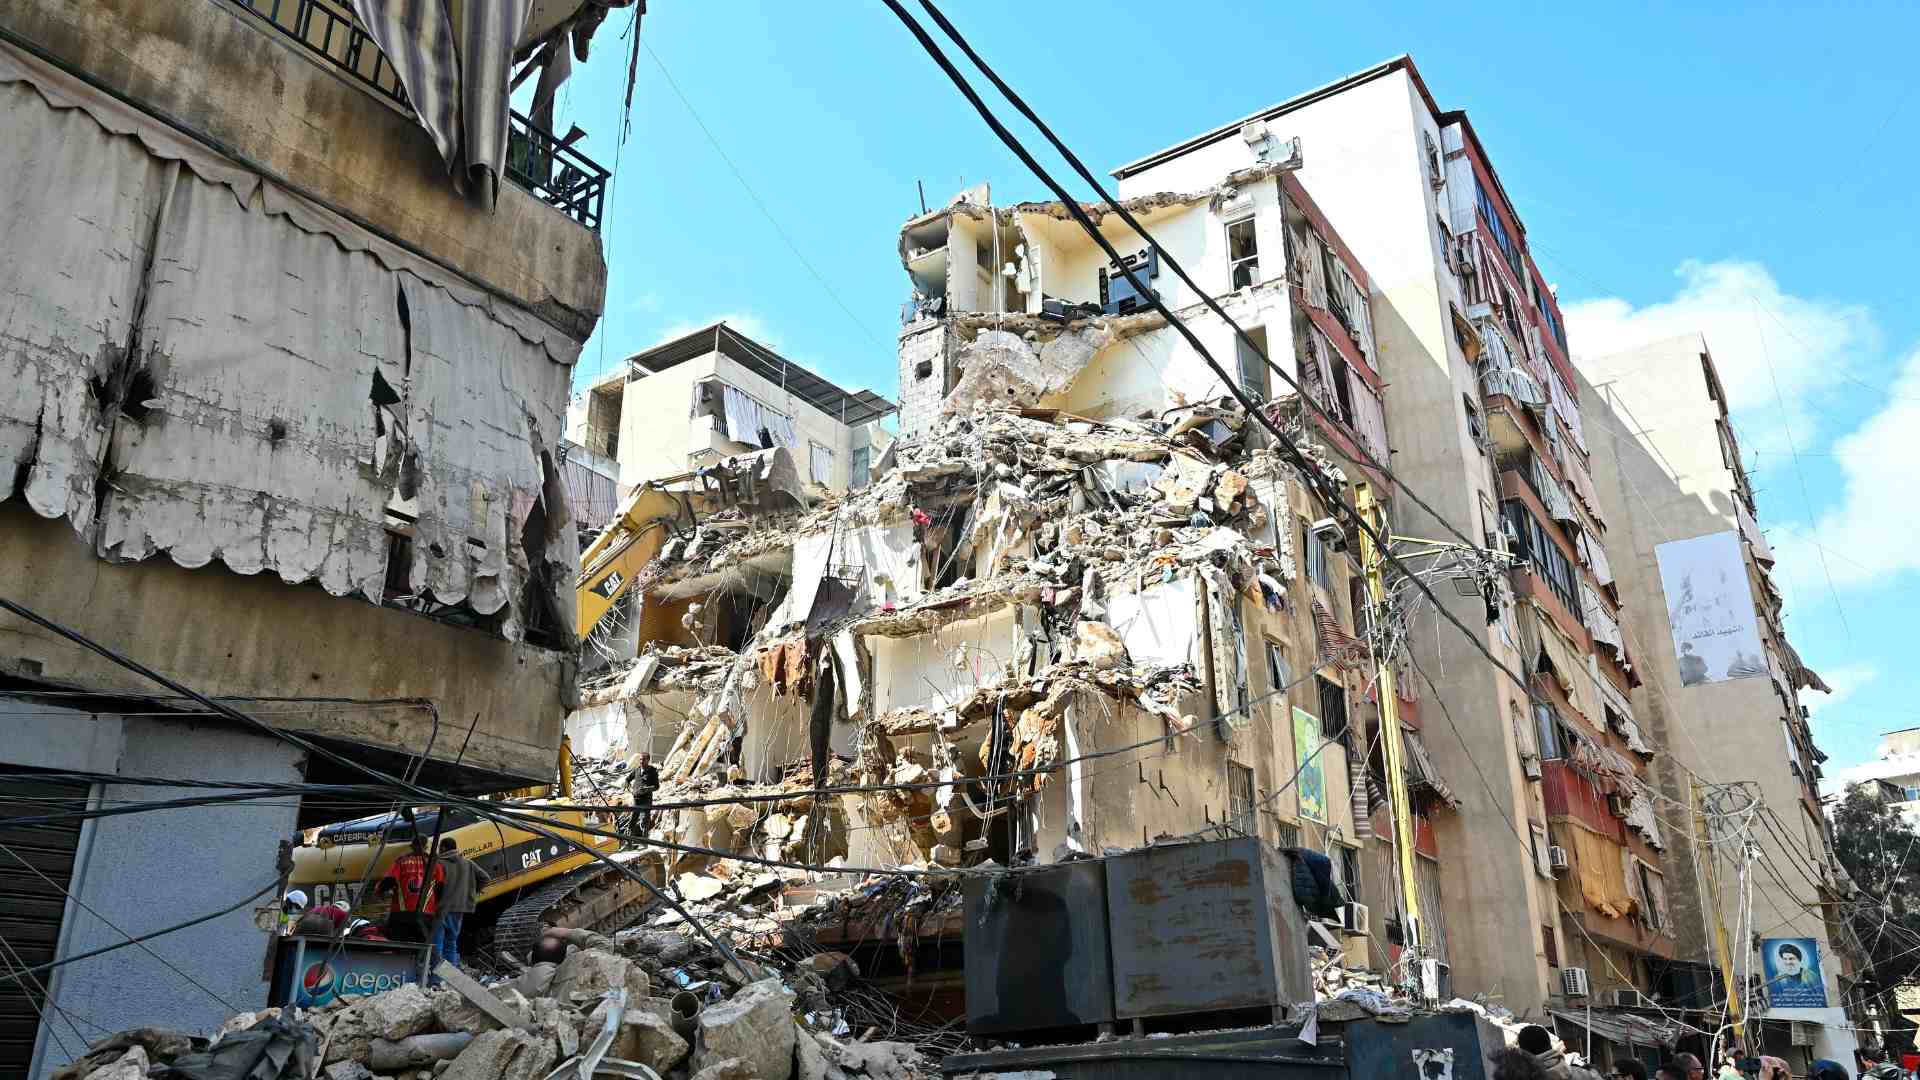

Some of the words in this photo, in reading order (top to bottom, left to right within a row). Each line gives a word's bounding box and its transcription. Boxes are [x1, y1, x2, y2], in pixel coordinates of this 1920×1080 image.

[604, 571, 622, 595] CAT
[333, 831, 369, 842] CATERPIL
[521, 848, 542, 869] CAT
[341, 970, 407, 994] pepsi
